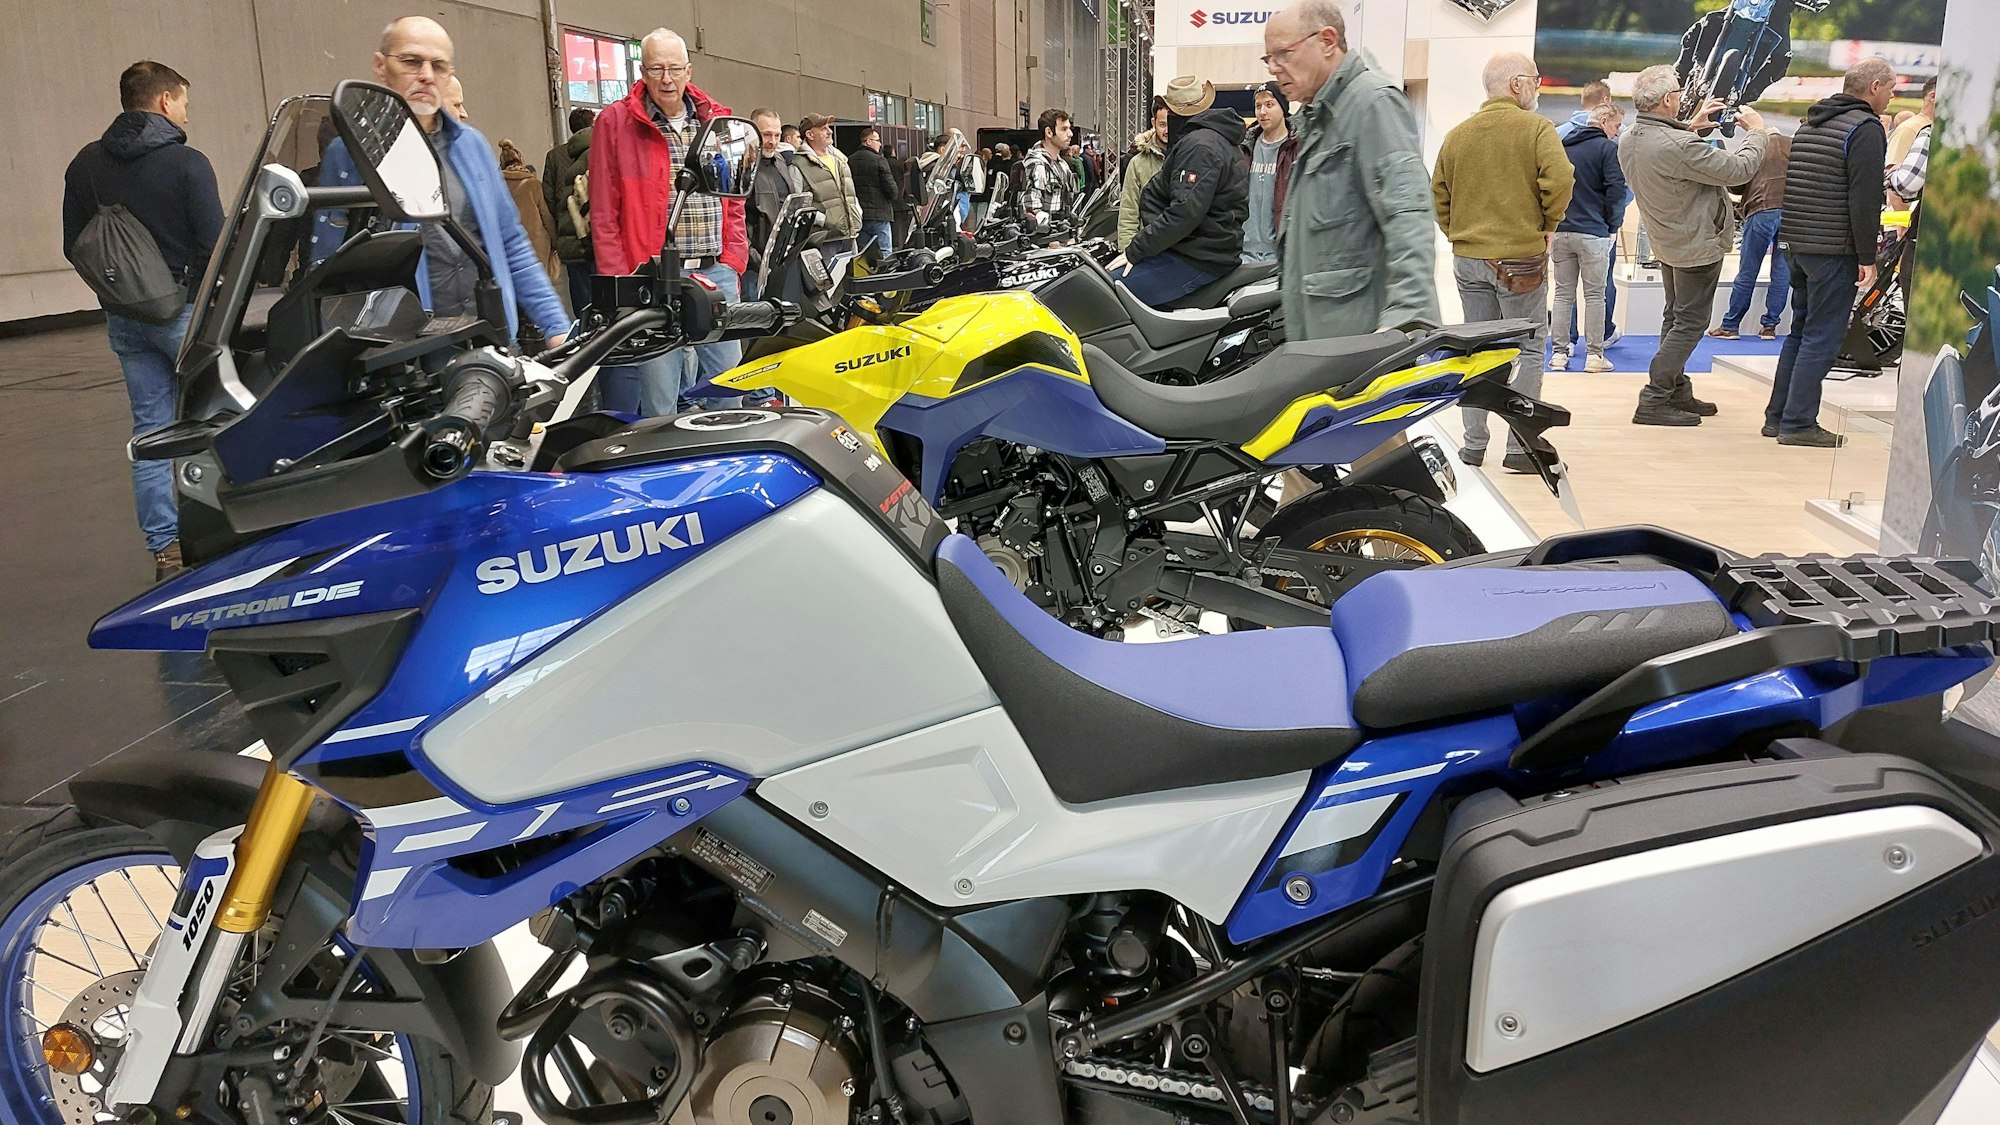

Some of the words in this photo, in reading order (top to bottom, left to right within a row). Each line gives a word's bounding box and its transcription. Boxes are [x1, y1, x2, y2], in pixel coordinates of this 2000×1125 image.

[1212, 11, 1282, 24] SUZU
[1001, 267, 1060, 288] SUZUKI
[834, 345, 911, 374] SUZUKI
[475, 511, 705, 595] SUZUKI
[170, 594, 290, 631] V-STROM
[291, 579, 365, 608] DE
[182, 879, 214, 952] 1050
